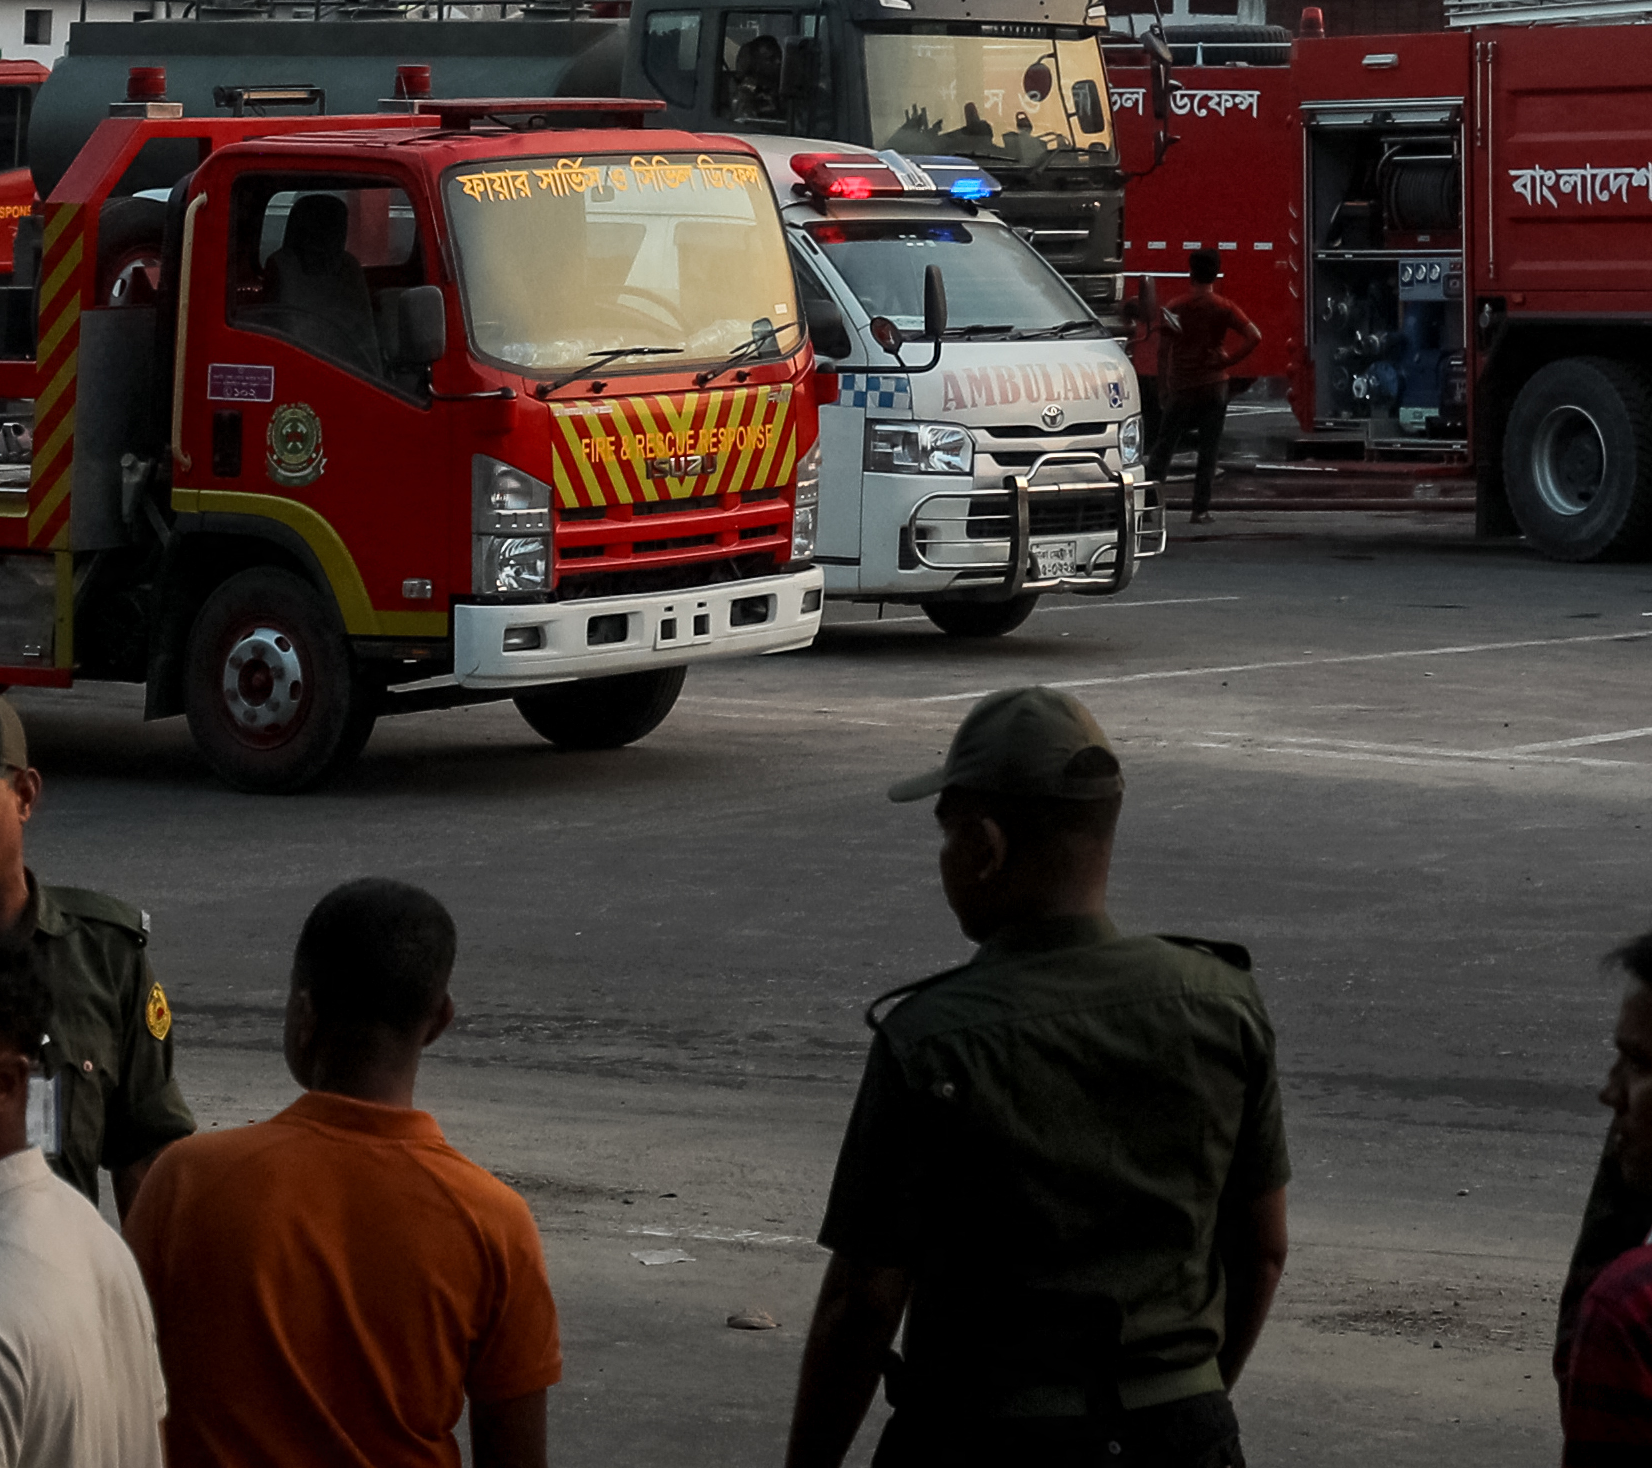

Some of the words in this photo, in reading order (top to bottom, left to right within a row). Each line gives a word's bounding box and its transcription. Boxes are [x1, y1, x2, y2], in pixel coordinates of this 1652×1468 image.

[456, 169, 532, 203] ফায়ার
[533, 157, 604, 198] সার্ভিস
[608, 167, 629, 192] ও
[630, 155, 696, 192] সিভিল
[697, 154, 763, 191] ডিফেন্স
[942, 362, 1131, 412] AMBULANCE
[581, 436, 616, 463] FIRE
[620, 435, 632, 460] &
[635, 429, 695, 458] RESCUE
[699, 423, 775, 453] RESPONSE
[646, 455, 718, 480] ISUZU
